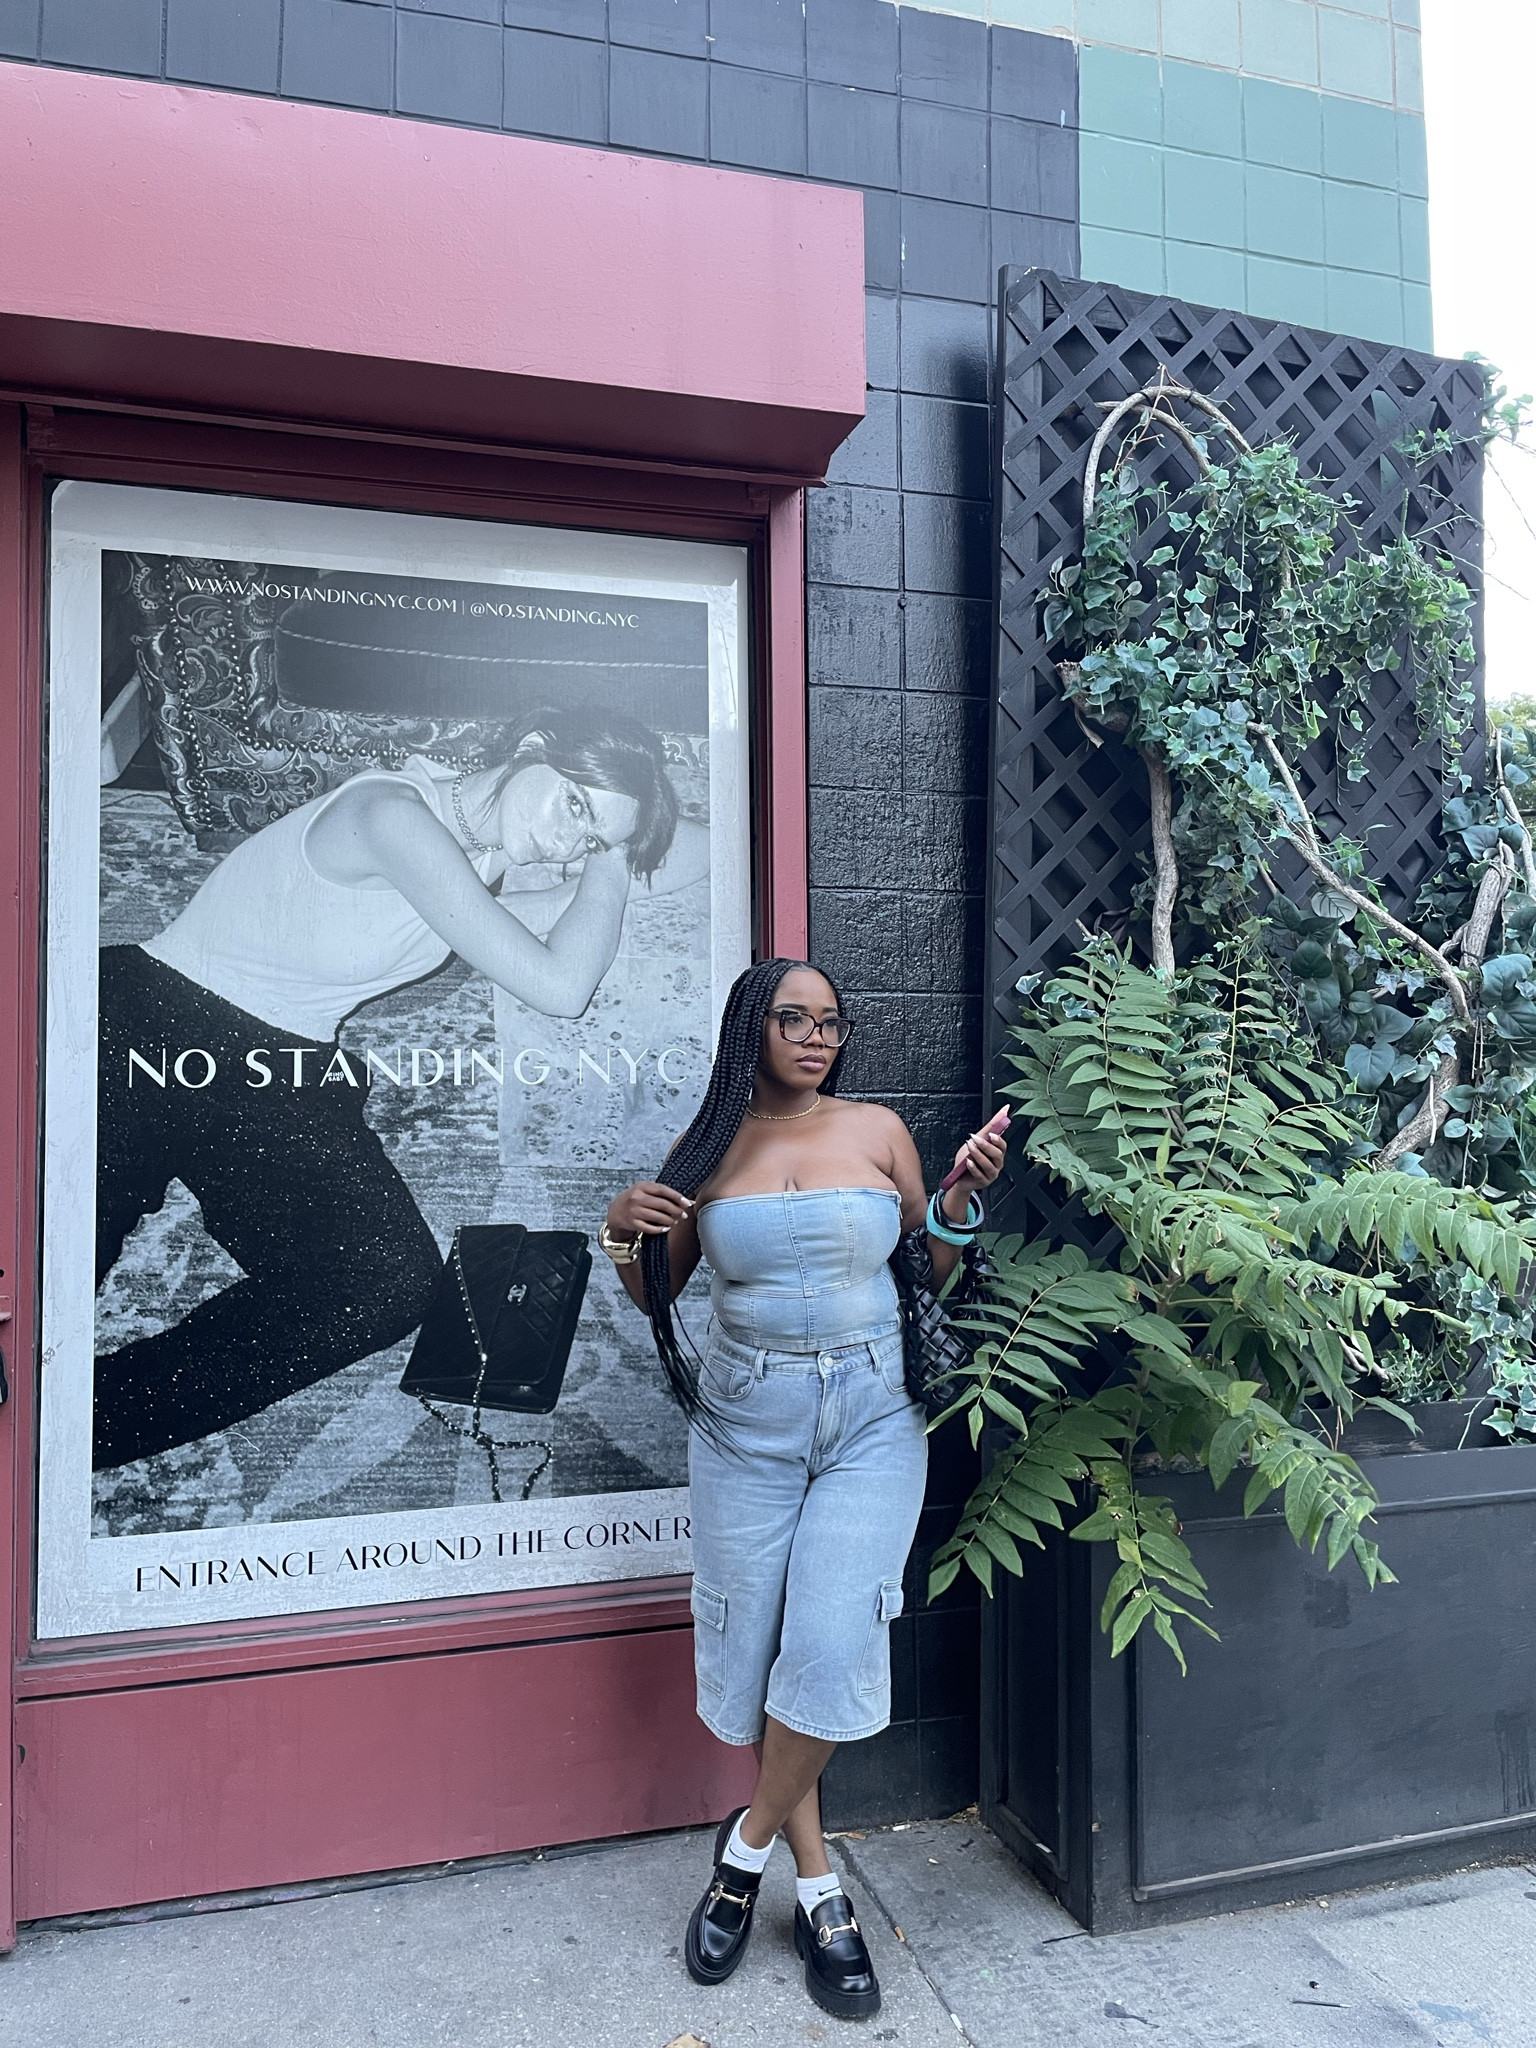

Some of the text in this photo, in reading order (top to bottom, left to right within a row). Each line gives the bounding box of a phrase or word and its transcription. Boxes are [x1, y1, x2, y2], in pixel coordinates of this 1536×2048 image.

[185, 576, 457, 613] WWW.NOSTANDINGNYC.COM
[470, 601, 640, 628] @NO.STANDING.NYC
[129, 1048, 687, 1088] NO STANDING NYC
[136, 1516, 692, 1592] ENTRANCE AROUND THE CORNER
